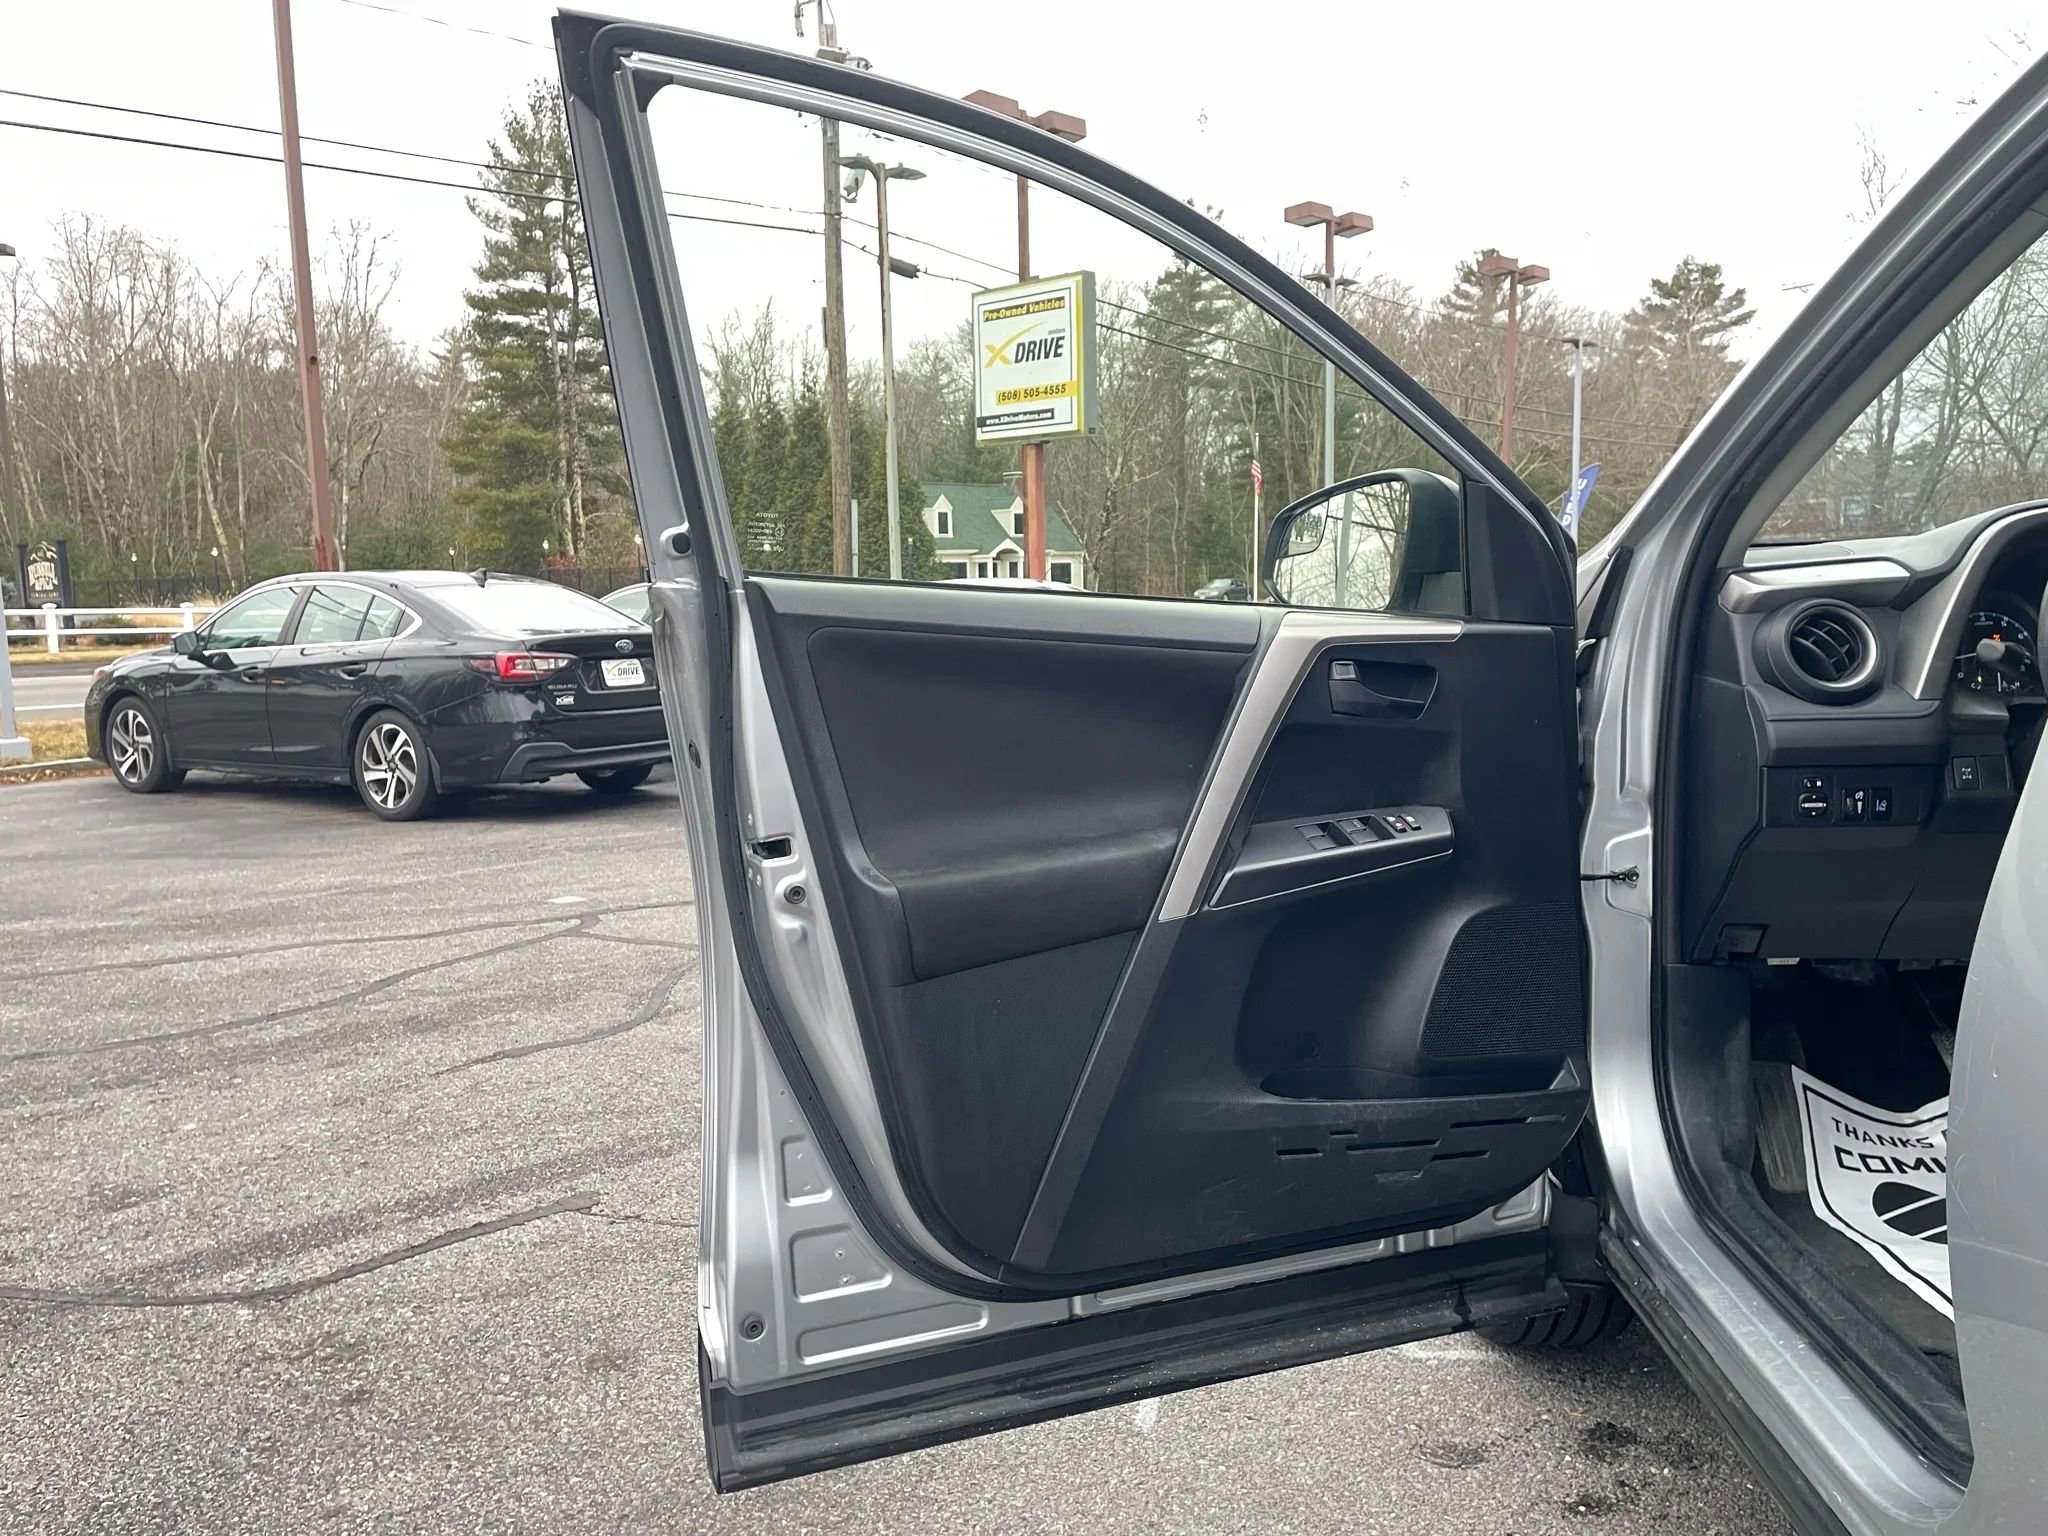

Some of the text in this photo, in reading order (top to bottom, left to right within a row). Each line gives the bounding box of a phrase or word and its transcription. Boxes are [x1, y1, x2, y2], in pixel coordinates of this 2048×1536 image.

[985, 299, 1065, 321] Pre-Owned Vehicles
[998, 383, 1067, 403] (508) 505-4555
[617, 666, 640, 677] DRIVE
[1831, 1116, 1935, 1149] THANKS
